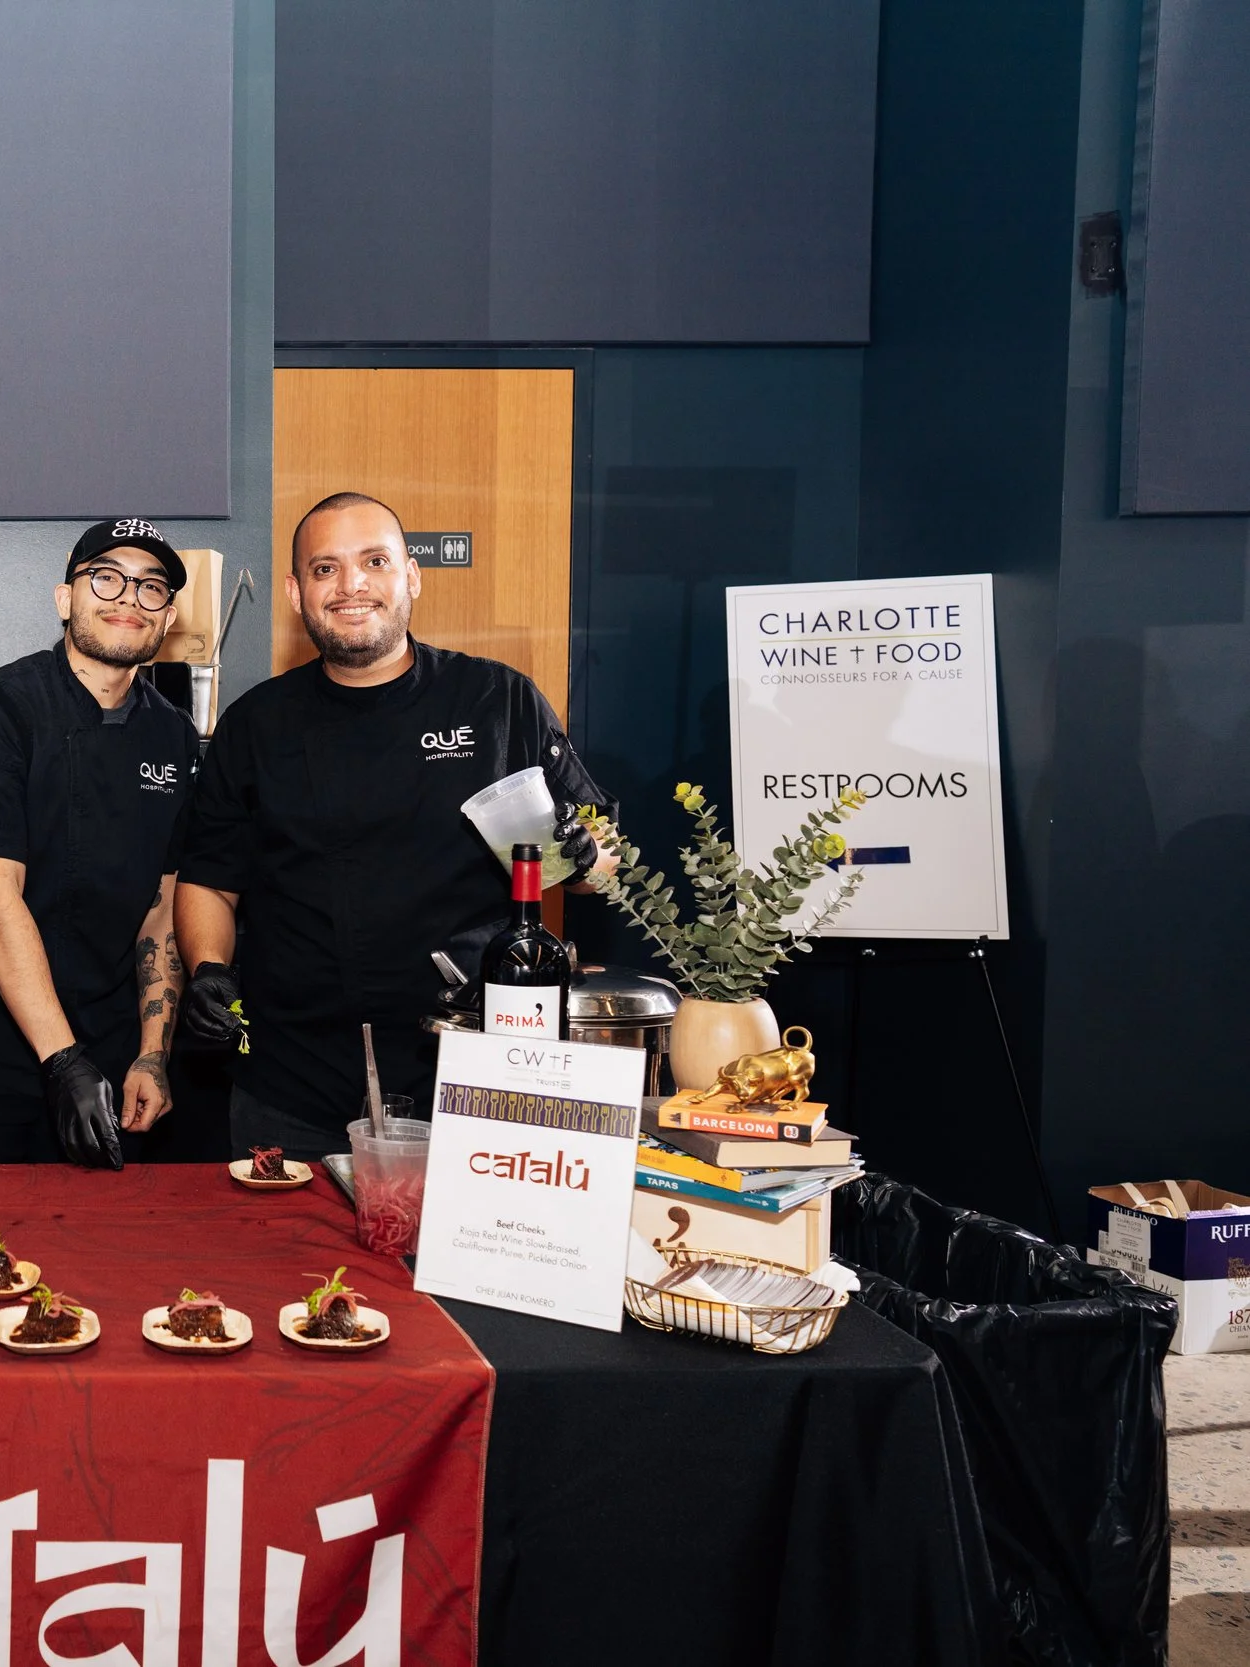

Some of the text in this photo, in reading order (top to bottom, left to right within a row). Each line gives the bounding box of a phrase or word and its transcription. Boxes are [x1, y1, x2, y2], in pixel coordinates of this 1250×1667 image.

[759, 605, 961, 635] CHARLOTTE
[760, 646, 838, 667] WINE
[876, 642, 962, 664] FOOD
[760, 668, 963, 685] CONNOISSEURS FOR A CAUSE
[425, 751, 474, 762] HOSPITALITY
[763, 772, 968, 799] RESTROOMS
[535, 1078, 560, 1087] TRUIST
[693, 1116, 775, 1135] BARCELONA
[646, 1176, 679, 1190] TAPAS
[1113, 1205, 1158, 1226] RUFFINO
[459, 1226, 480, 1239] Rioja
[482, 1230, 498, 1241] Red
[500, 1233, 523, 1246] Wine
[496, 1219, 545, 1236] Beef Cheeks
[452, 1238, 498, 1254] Cauliflower
[528, 1251, 558, 1266] Pickled
[560, 1258, 588, 1271] Onion
[475, 1285, 556, 1309] CHEF JUAN ROMERO
